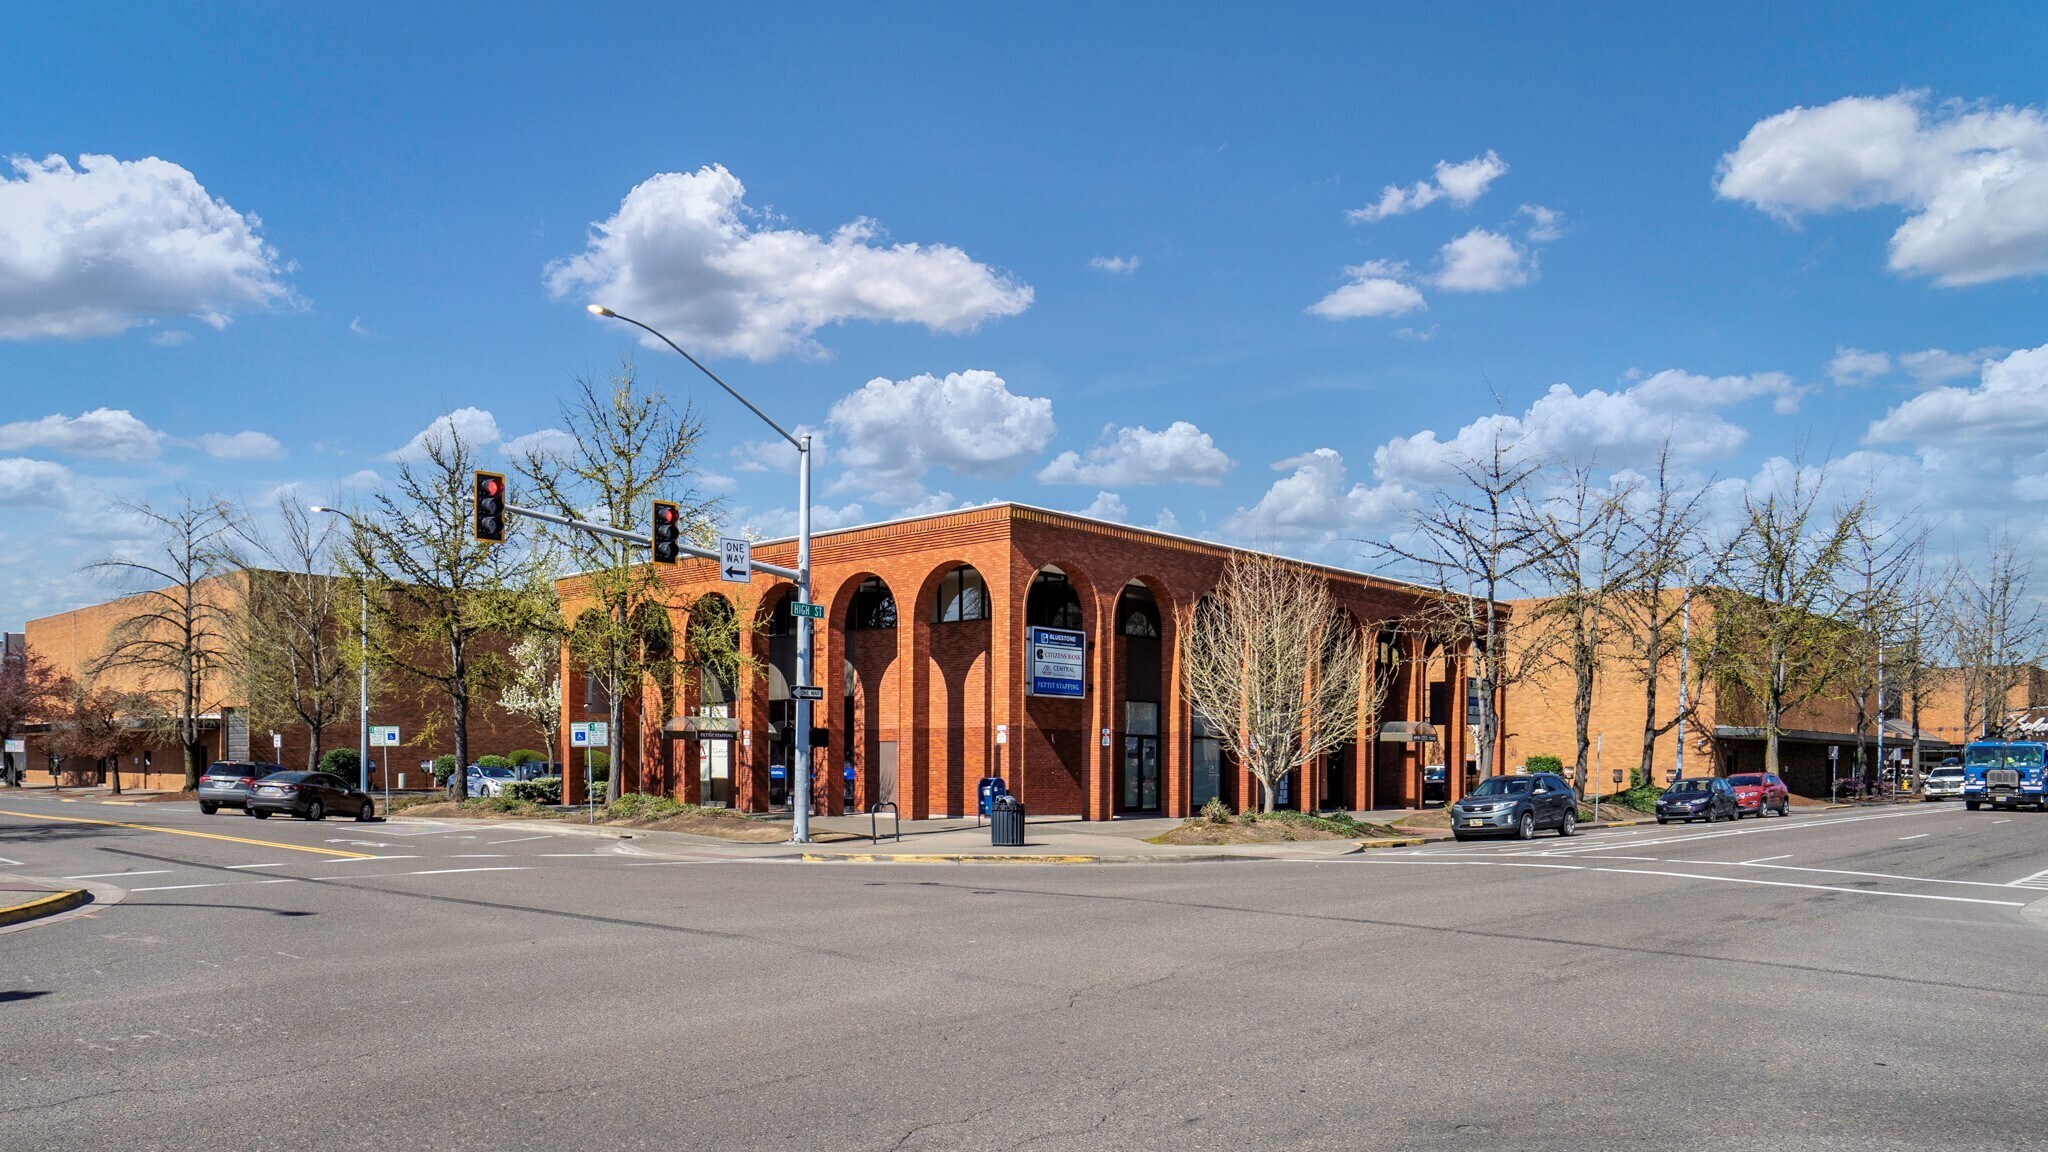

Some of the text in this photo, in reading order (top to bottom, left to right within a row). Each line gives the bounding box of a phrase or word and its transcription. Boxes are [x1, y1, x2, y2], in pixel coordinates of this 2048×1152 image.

[726, 542, 744, 553] ONE
[726, 554, 745, 564] WAY
[794, 603, 822, 617] HIGH ST
[1050, 634, 1076, 642] BLUESTONE
[1037, 681, 1080, 690] PETTIT STAFFING
